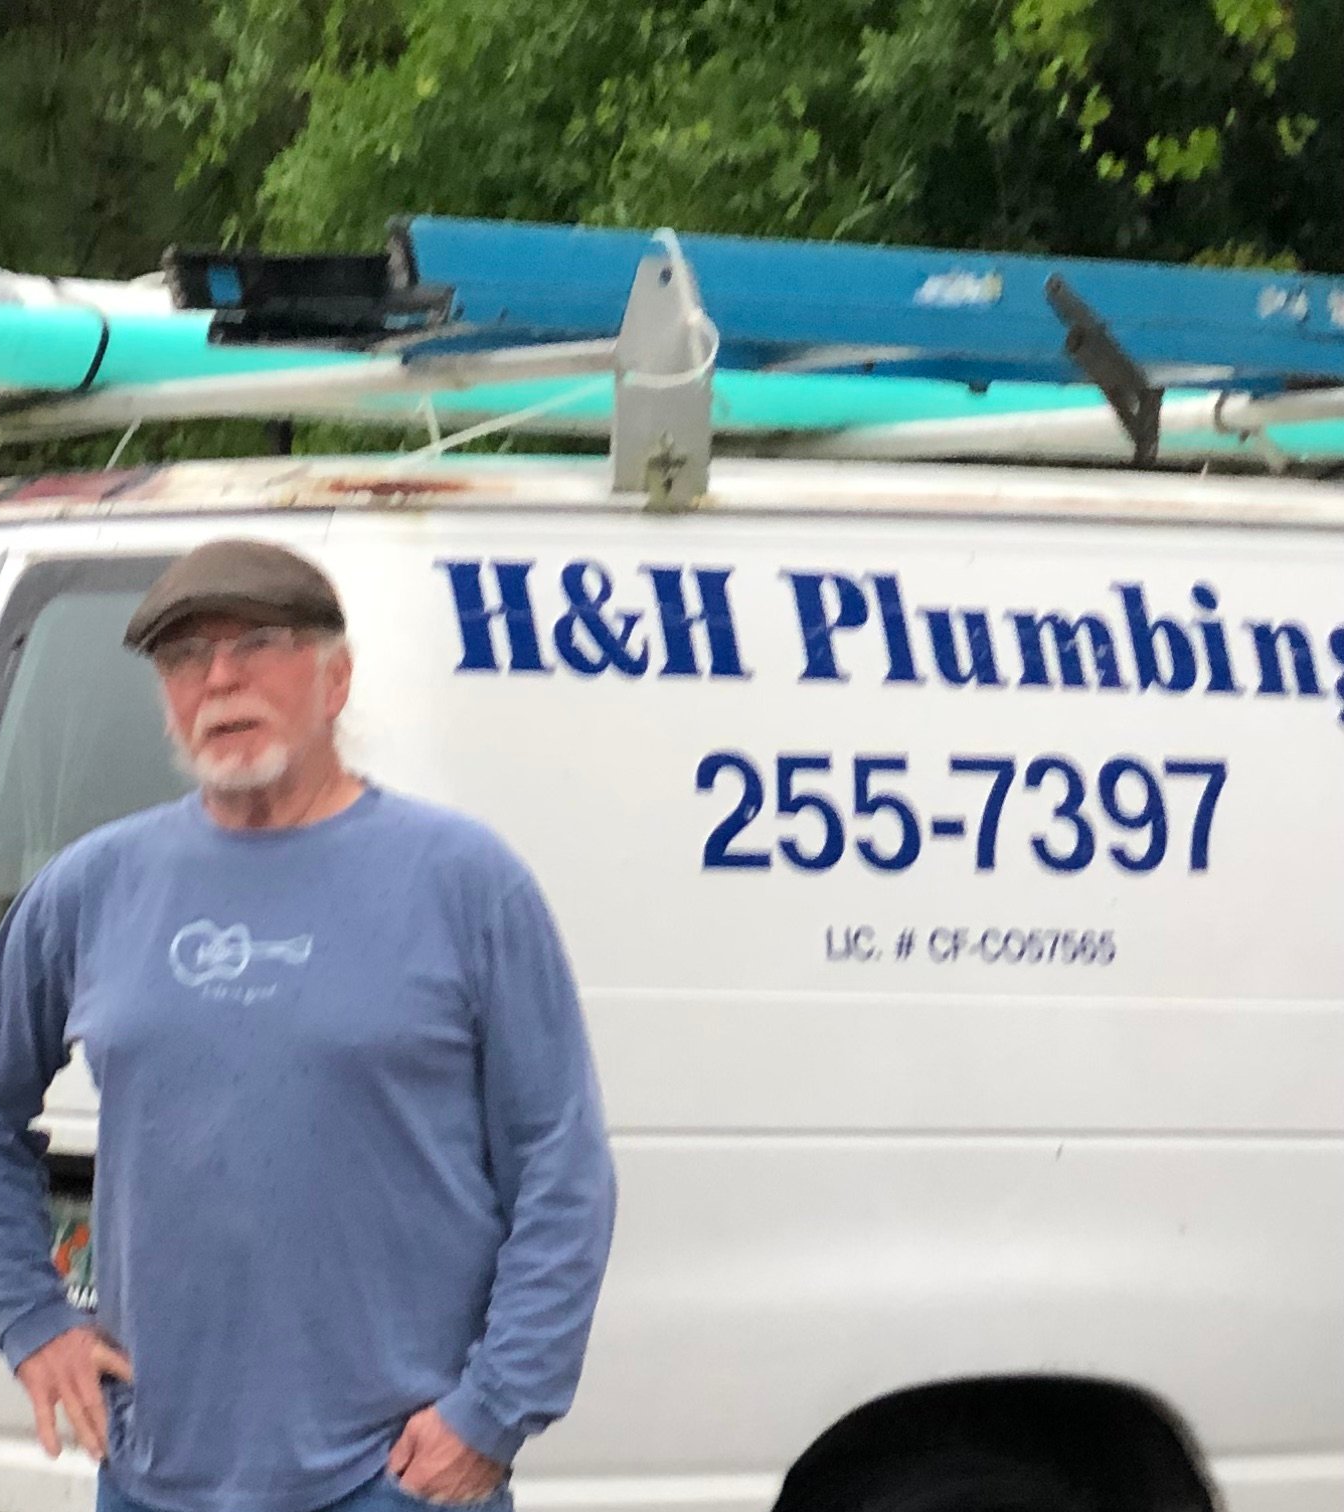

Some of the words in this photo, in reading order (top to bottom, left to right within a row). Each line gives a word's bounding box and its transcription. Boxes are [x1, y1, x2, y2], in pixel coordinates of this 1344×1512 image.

[432, 556, 754, 681] H&H
[778, 566, 1344, 736] Plumbin
[694, 750, 1229, 876] 255-7397
[824, 923, 882, 963] LIC.
[895, 924, 916, 961] #
